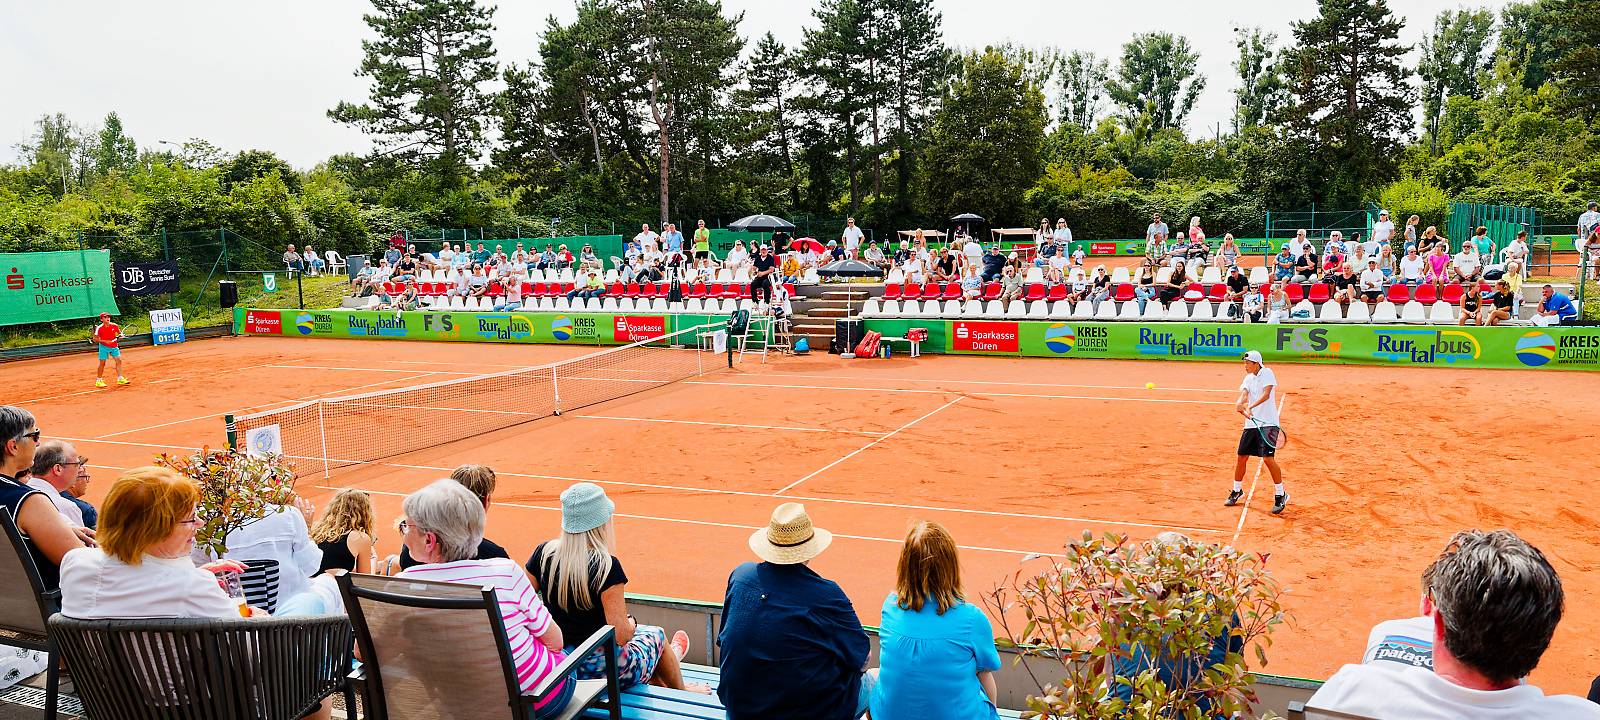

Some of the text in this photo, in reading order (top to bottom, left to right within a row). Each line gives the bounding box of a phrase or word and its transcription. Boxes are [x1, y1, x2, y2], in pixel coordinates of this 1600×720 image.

[121, 267, 145, 284] DTB
[32, 276, 94, 291] Sparkasse
[35, 294, 73, 306] Düren
[314, 315, 332, 323] KREIS
[574, 318, 596, 327] KREIS
[629, 324, 662, 333] Sparkasse
[1077, 326, 1108, 337] KREIS
[158, 334, 181, 343] 01:12
[972, 330, 1015, 341] Sparkasse
[972, 341, 998, 350] Düren
[1077, 338, 1108, 348] DÜREN
[1559, 335, 1600, 348] KREIS
[1558, 349, 1599, 359] DÜREN
